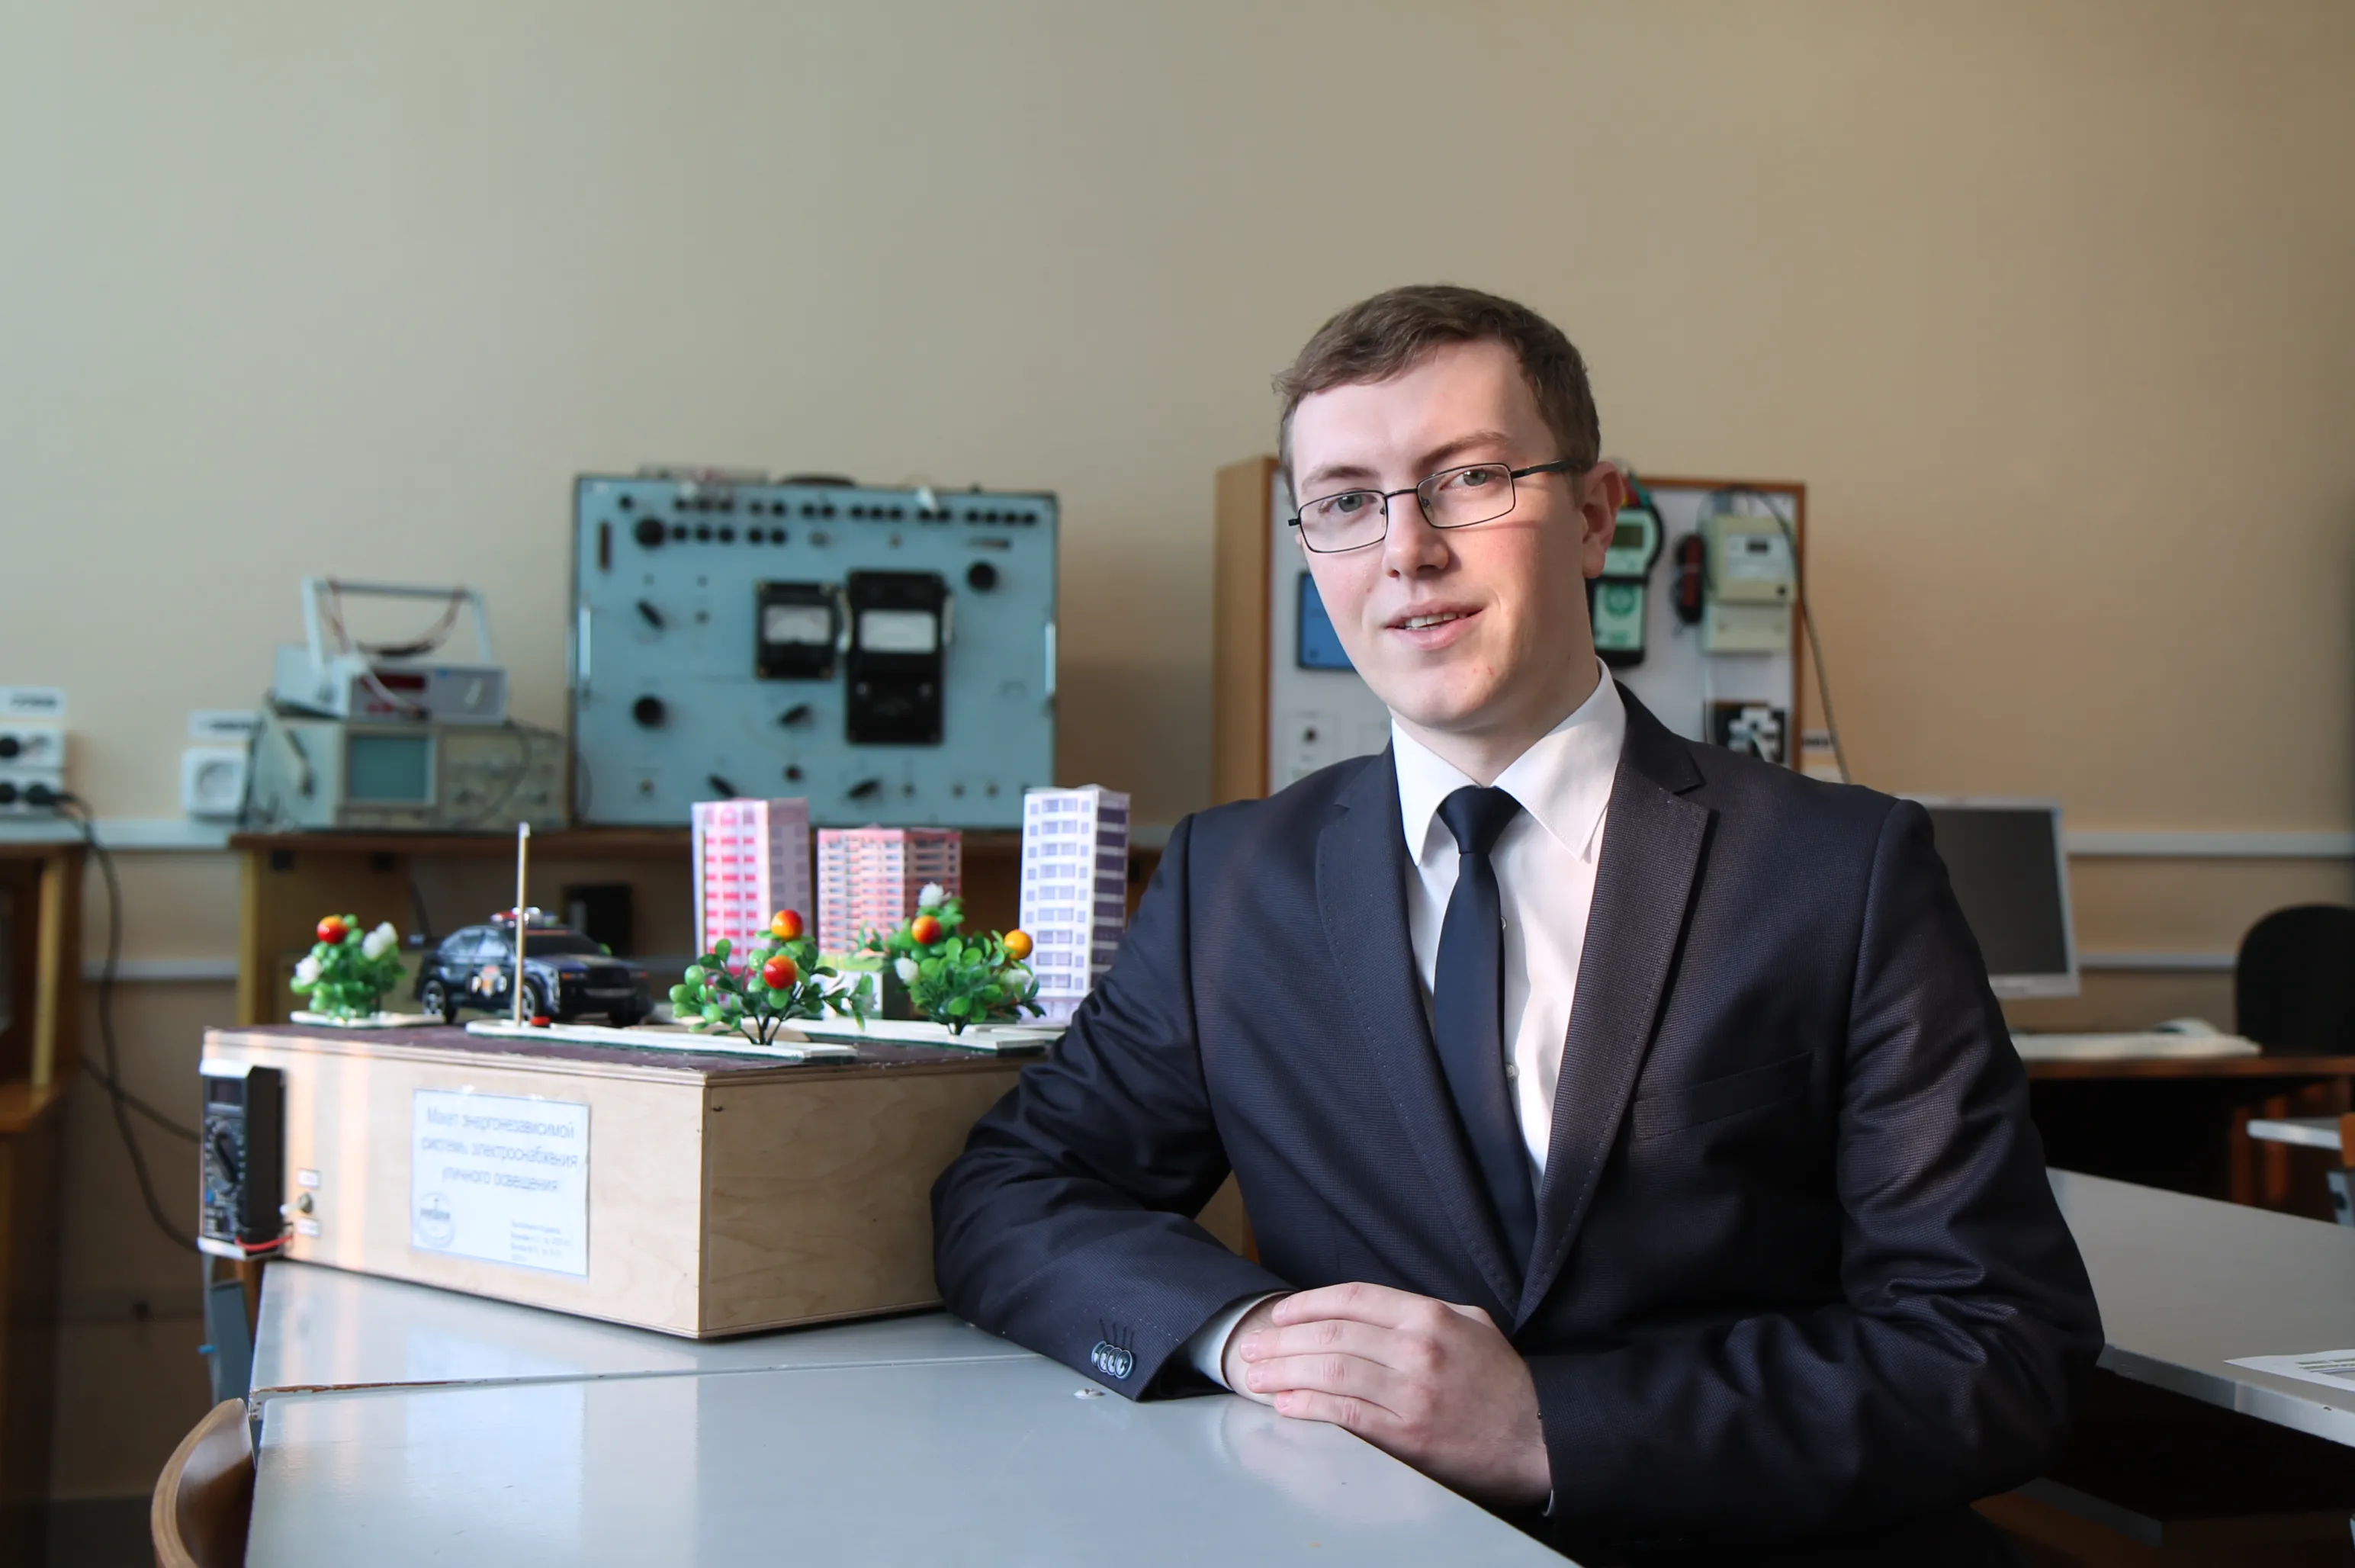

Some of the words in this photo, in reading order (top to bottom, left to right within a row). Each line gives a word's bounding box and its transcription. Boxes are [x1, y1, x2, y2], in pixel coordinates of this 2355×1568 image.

[461, 1113, 576, 1139] энергонезависимой
[471, 1142, 579, 1169] электроснабжения
[493, 1172, 559, 1194] освещения
